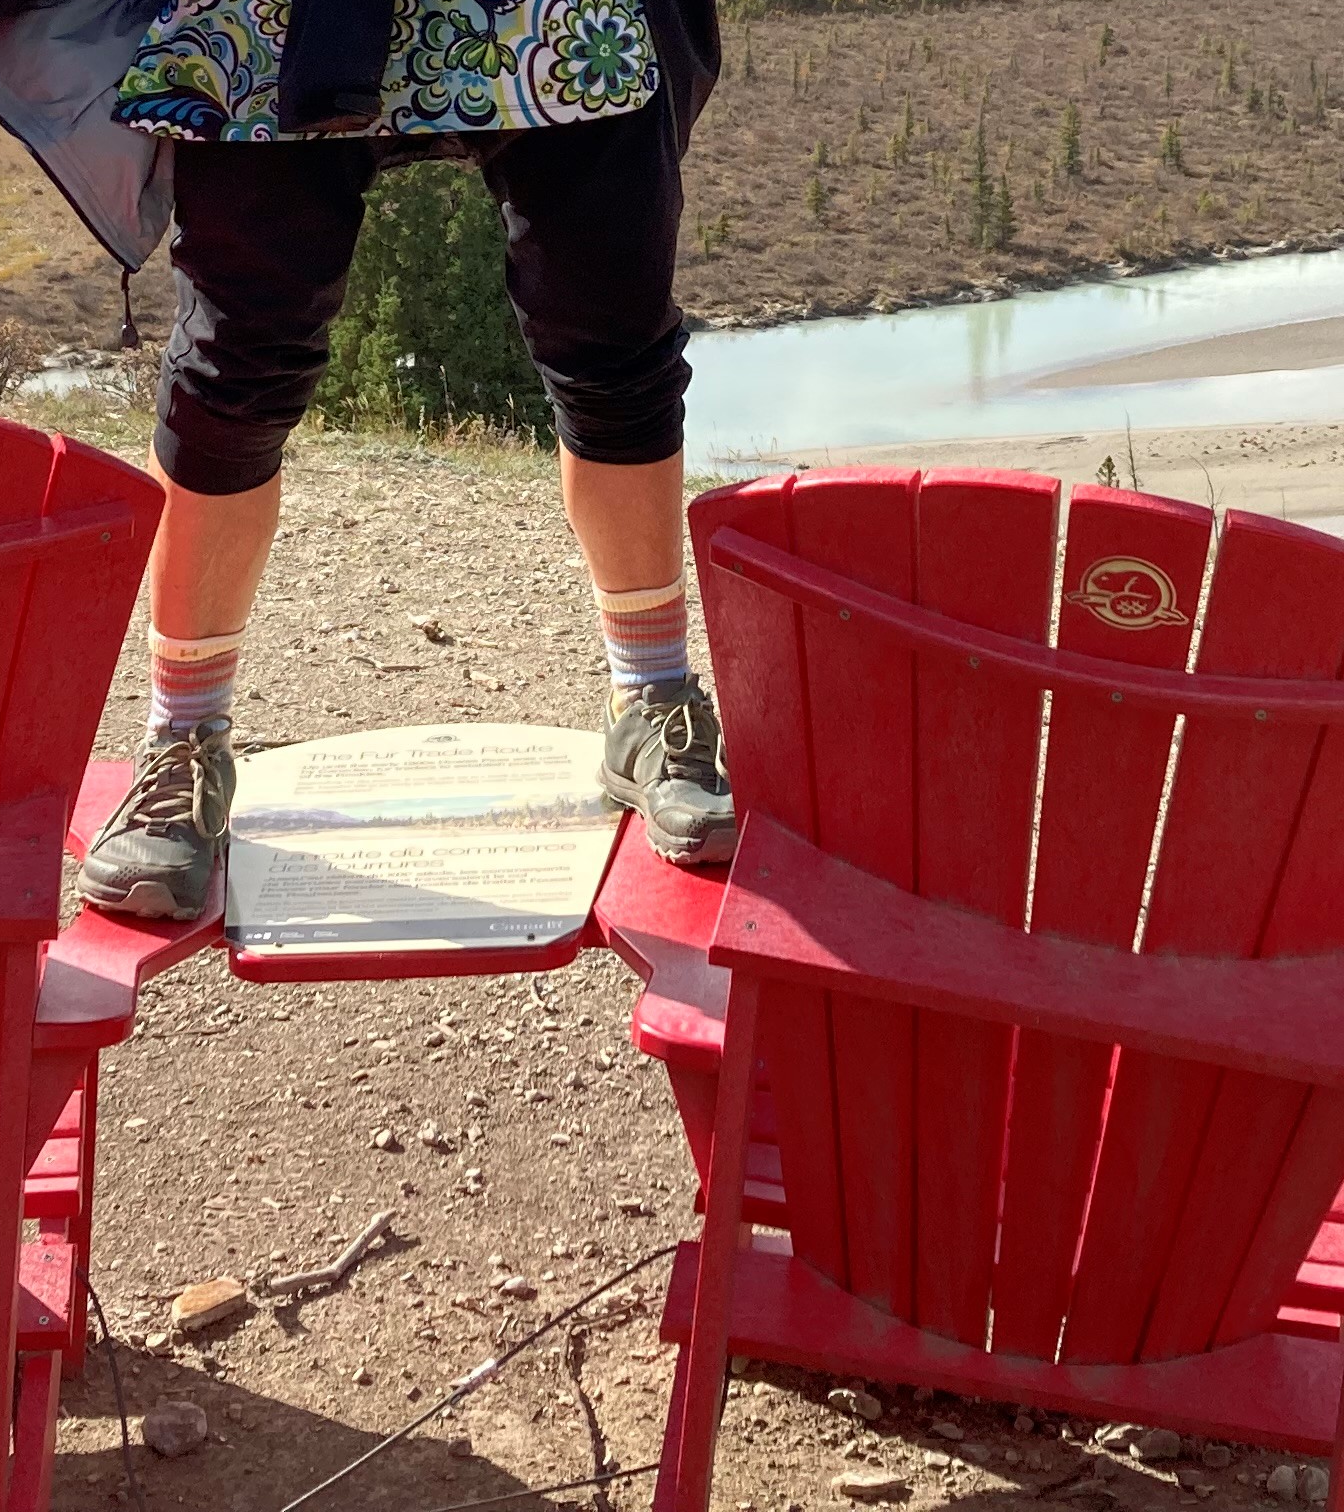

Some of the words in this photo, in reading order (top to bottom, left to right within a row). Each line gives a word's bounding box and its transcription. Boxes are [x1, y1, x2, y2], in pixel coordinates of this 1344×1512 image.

[307, 752, 353, 762] The
[360, 750, 399, 760] Fur
[405, 748, 473, 758] Trade
[480, 745, 553, 755] Route
[432, 843, 577, 856] commerce
[268, 863, 318, 873] des
